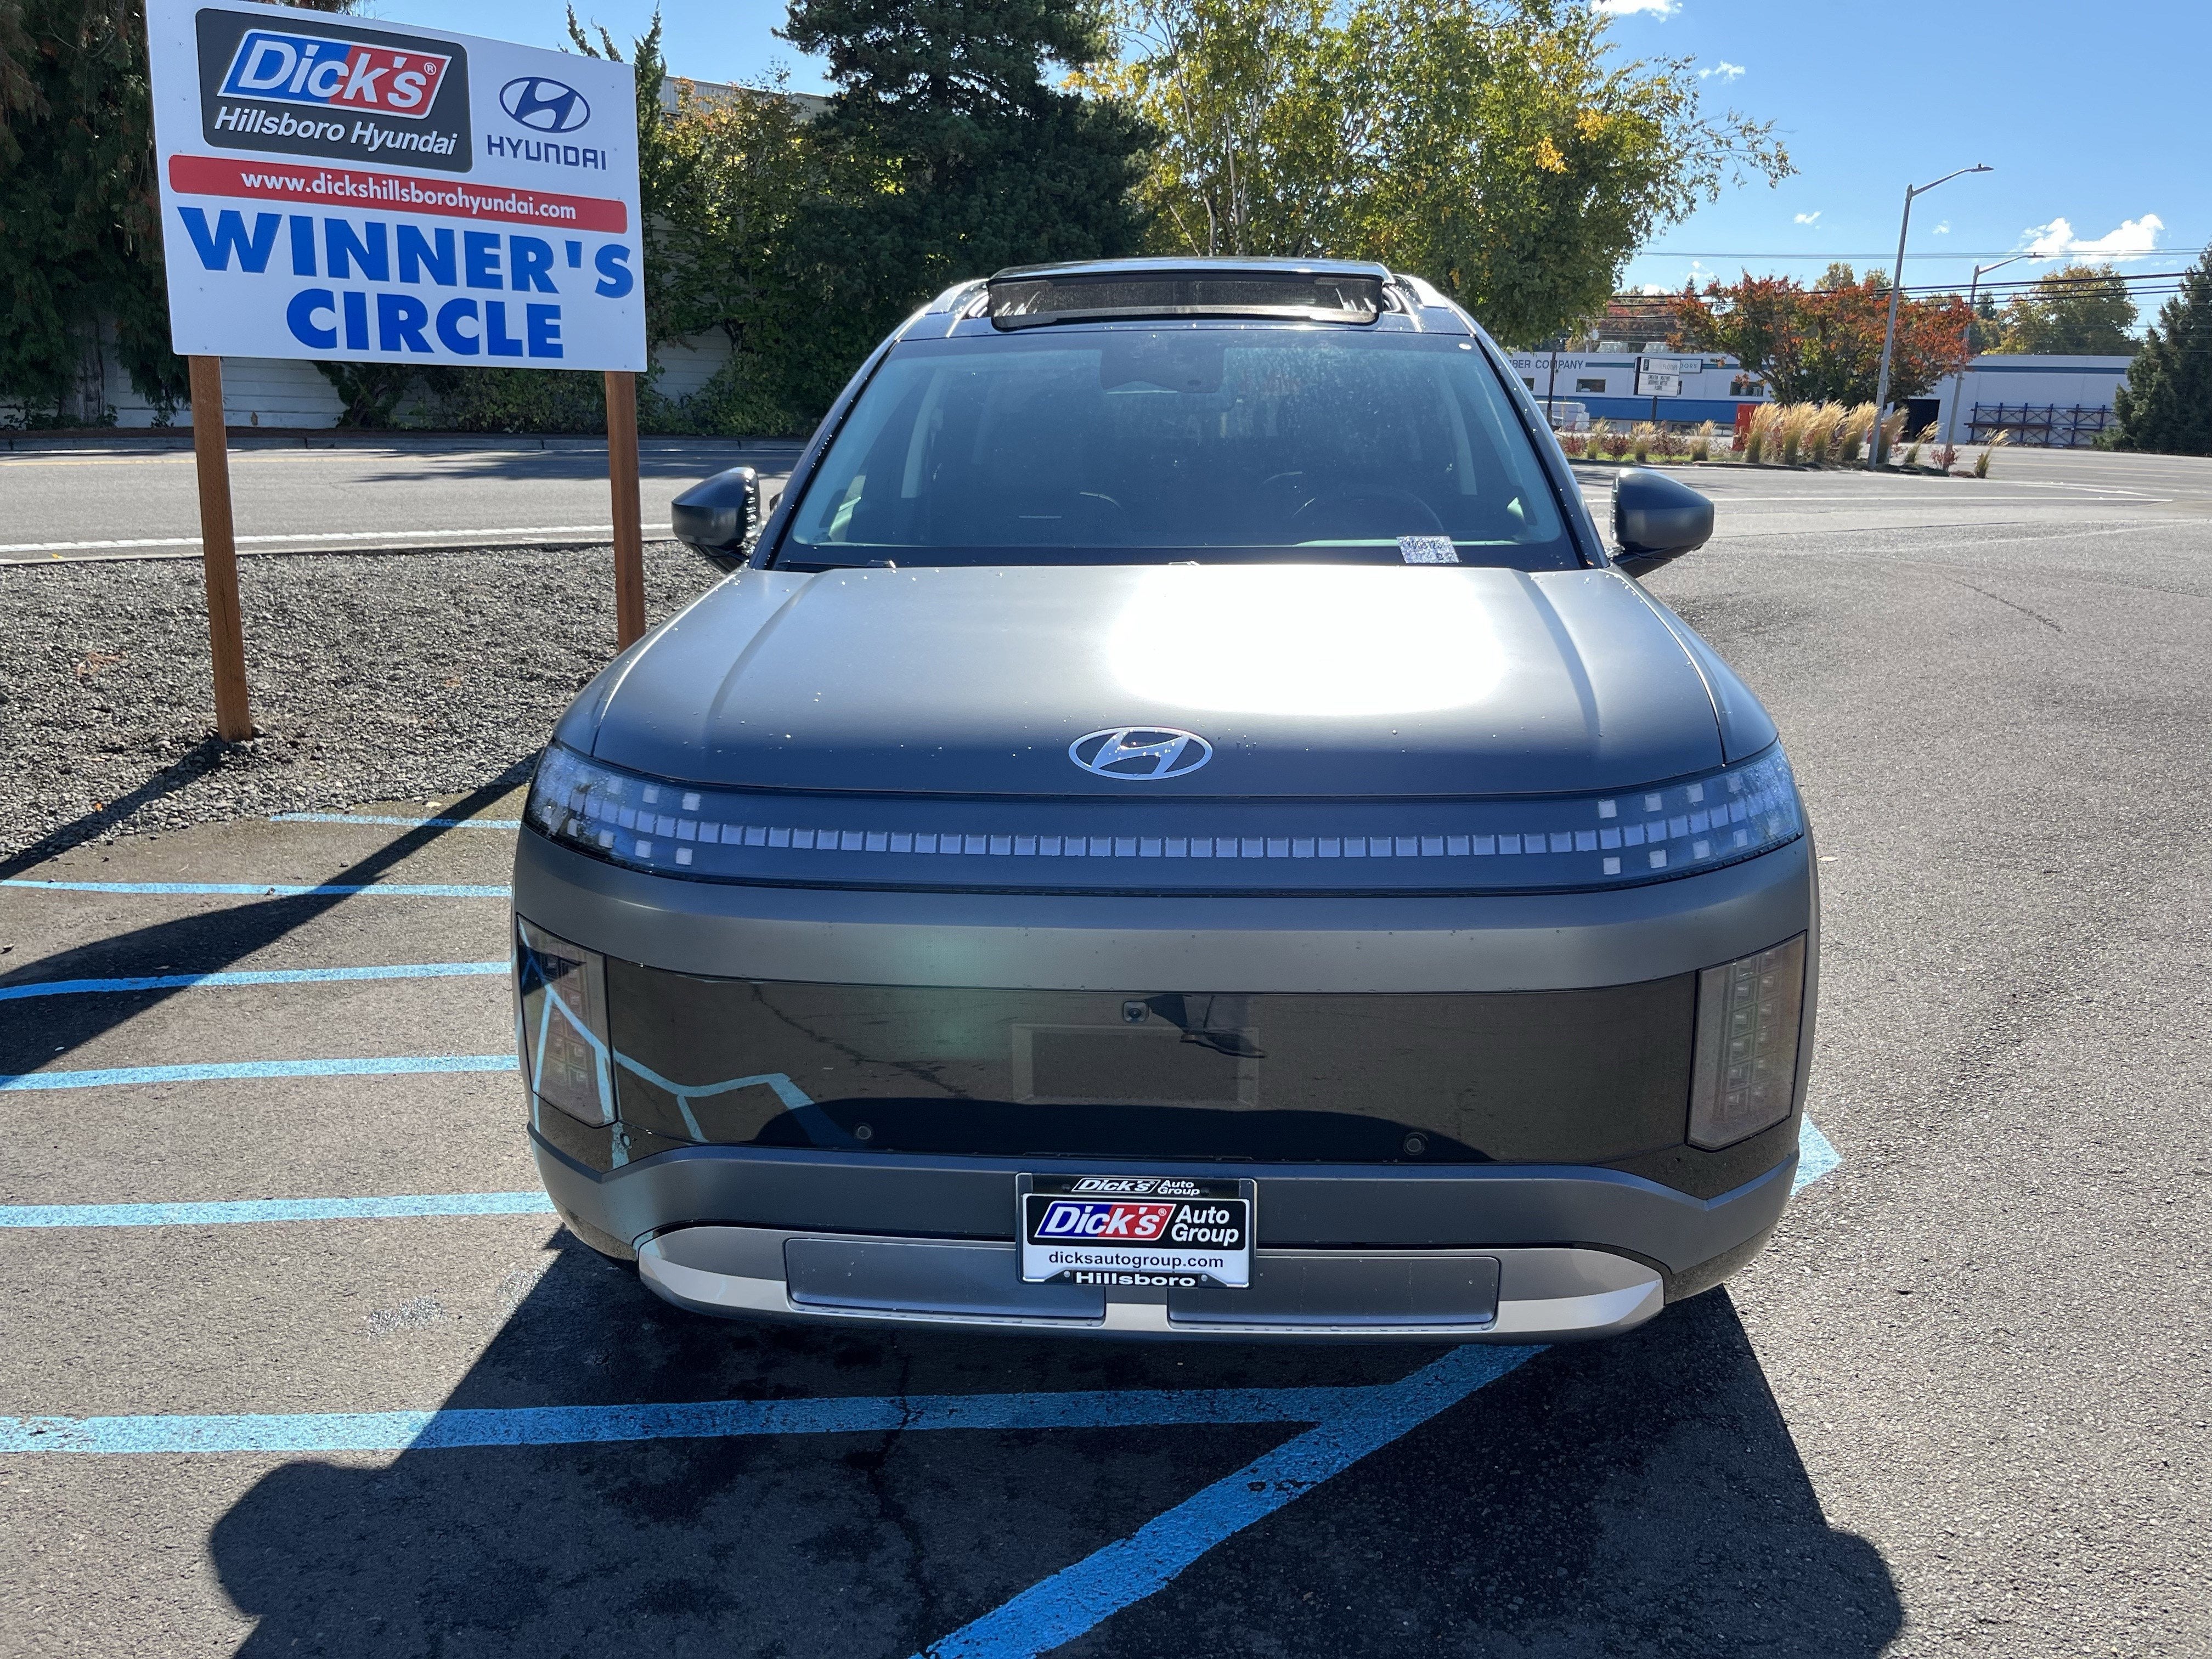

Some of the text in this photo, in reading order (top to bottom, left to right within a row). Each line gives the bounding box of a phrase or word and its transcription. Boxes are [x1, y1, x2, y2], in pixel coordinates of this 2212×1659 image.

[214, 106, 458, 155] Hillsboro Hyundai
[487, 134, 607, 171] HYUNDAI
[241, 172, 577, 220] www.dickshillsborohyundai.com
[177, 206, 634, 299] WINNER'S
[286, 288, 564, 359] CIRCLE
[1510, 359, 1531, 368] BER
[1158, 1187, 1200, 1196] Group
[1161, 1180, 1194, 1188] Auto
[1175, 1205, 1229, 1224] Auto
[1171, 1223, 1239, 1246] Group
[1049, 1251, 1223, 1268] dicksautogroup.com
[1076, 1272, 1196, 1286] Hillsboro
